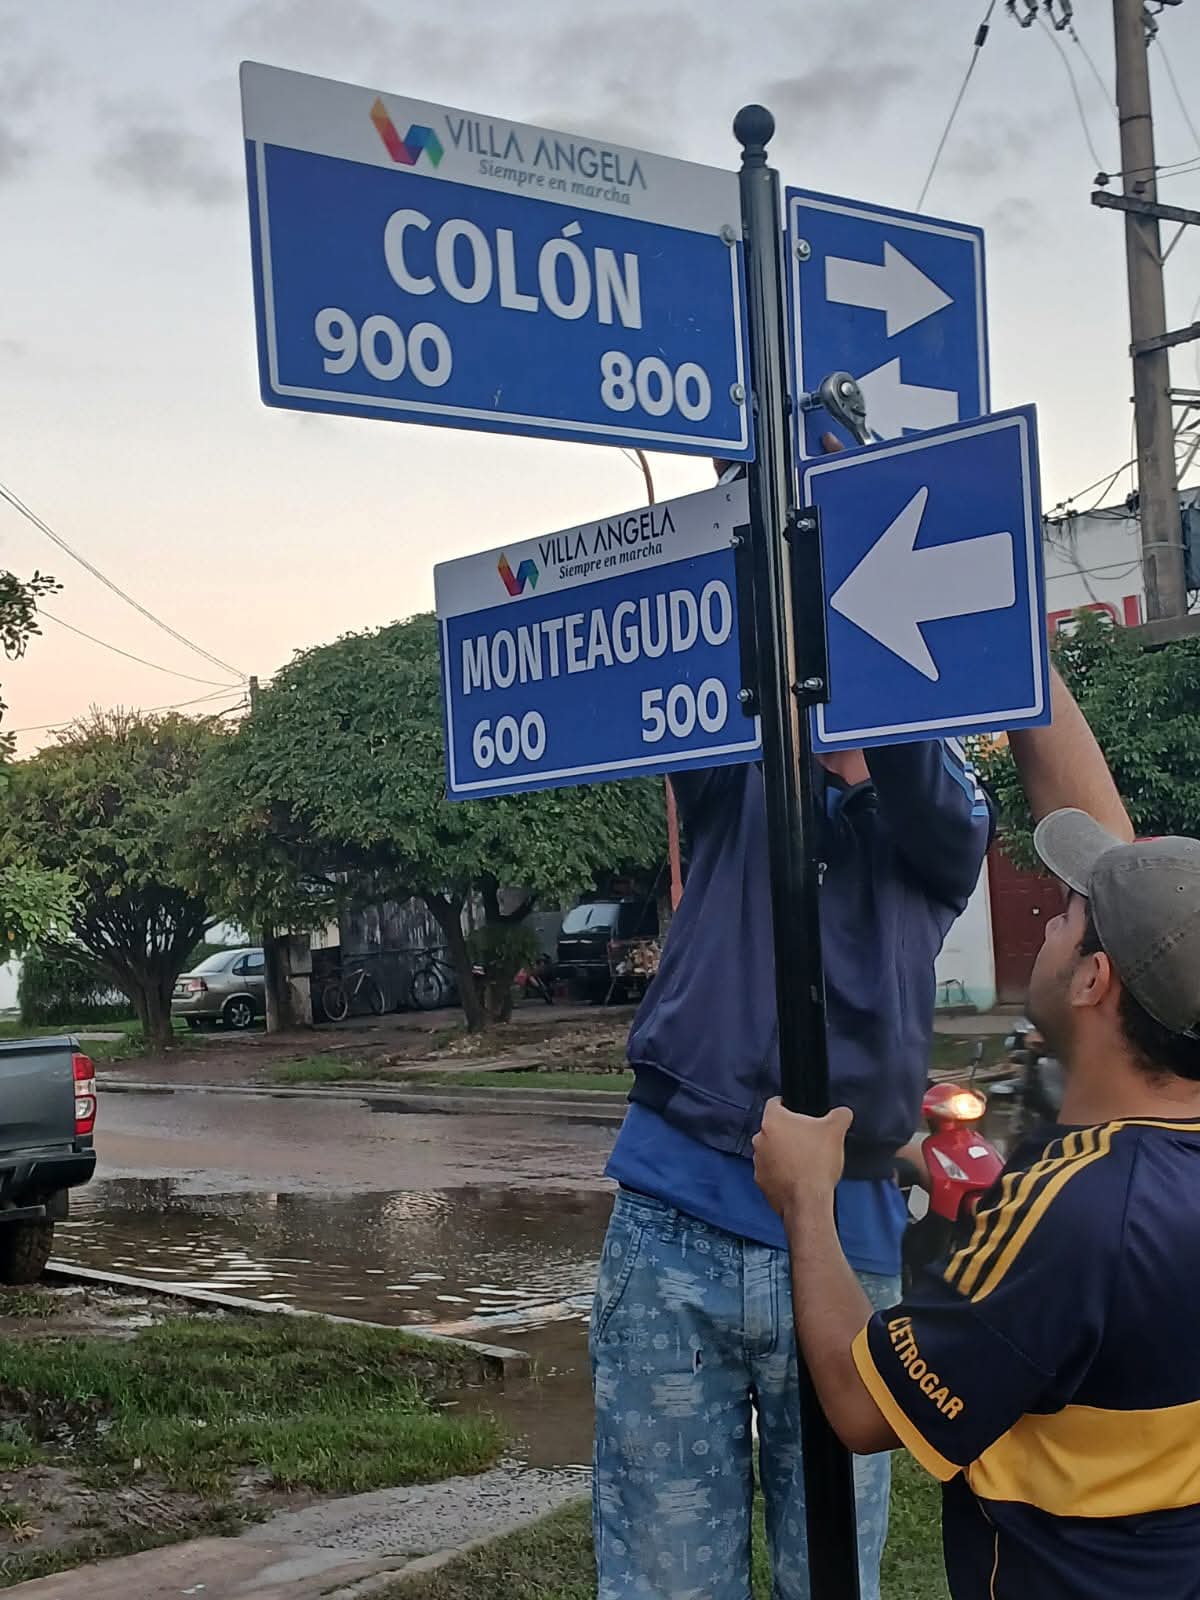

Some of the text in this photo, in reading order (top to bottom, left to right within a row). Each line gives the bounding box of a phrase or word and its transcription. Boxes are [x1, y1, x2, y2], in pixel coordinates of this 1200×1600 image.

[445, 115, 647, 190] VILLA ANGELA
[479, 159, 630, 205] Siempre en marcha
[384, 209, 642, 329] COLÓN
[314, 308, 711, 421] 900 800
[539, 506, 676, 568] VILLA ANGELA
[559, 541, 662, 579] Siempre en marcha
[461, 580, 732, 695] MONTEAGUDO
[472, 678, 728, 769] 600 500
